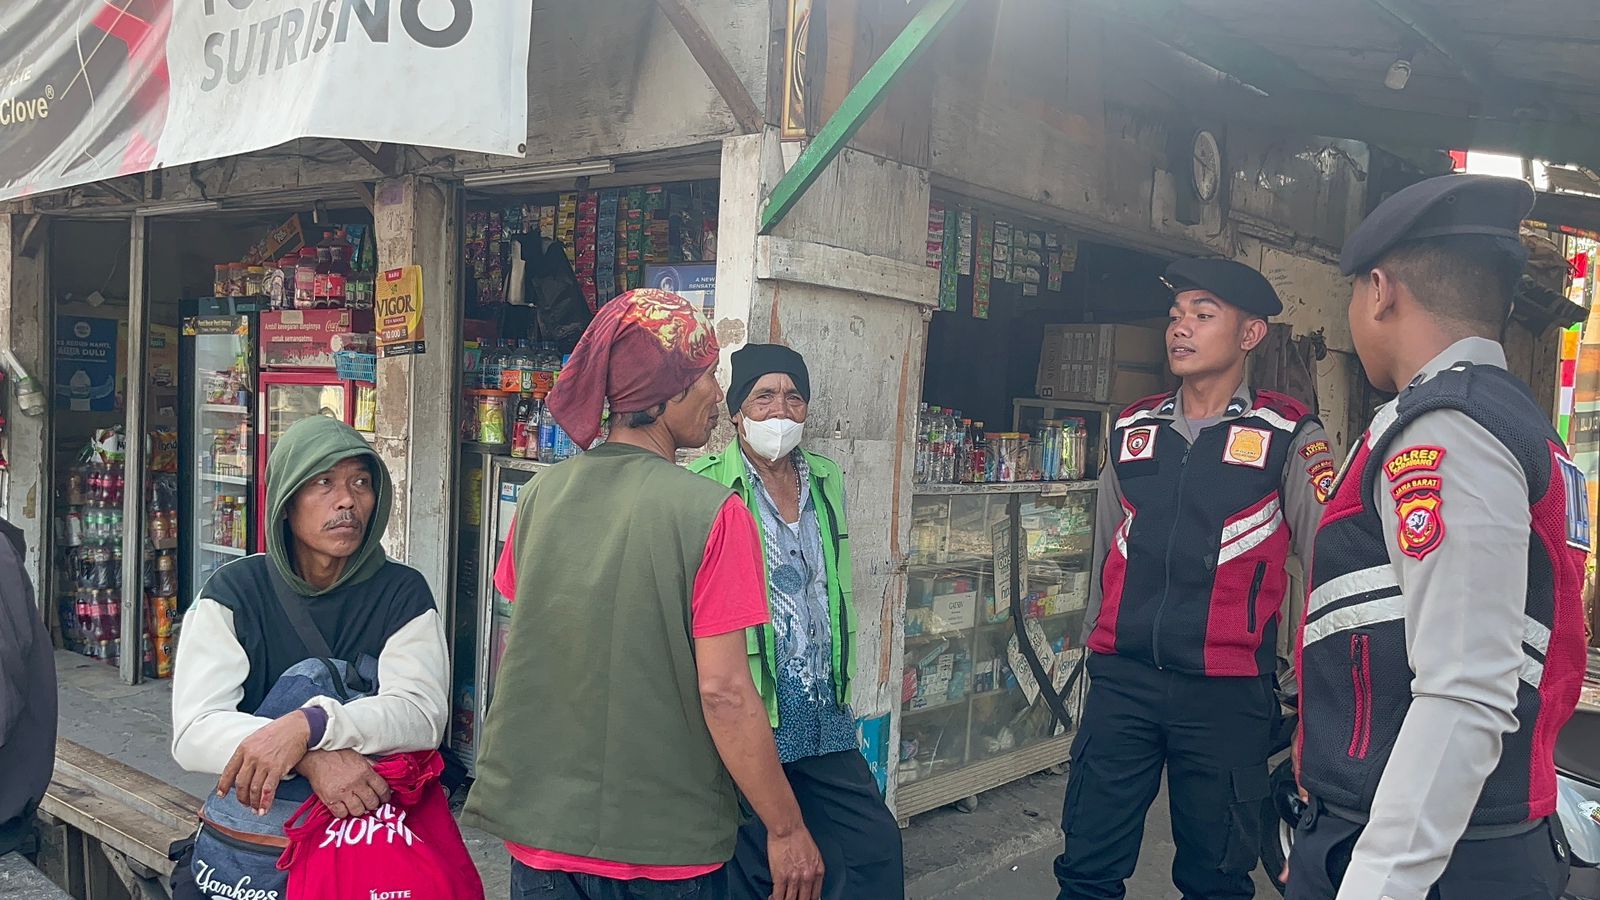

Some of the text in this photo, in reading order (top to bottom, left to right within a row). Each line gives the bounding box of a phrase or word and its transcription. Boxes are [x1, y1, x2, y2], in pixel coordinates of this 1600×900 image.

[376, 294, 416, 317] VIGOR
[1388, 449, 1439, 473] POLRES
[1395, 478, 1438, 496] JAWA BARAT
[196, 860, 279, 900] Yankees
